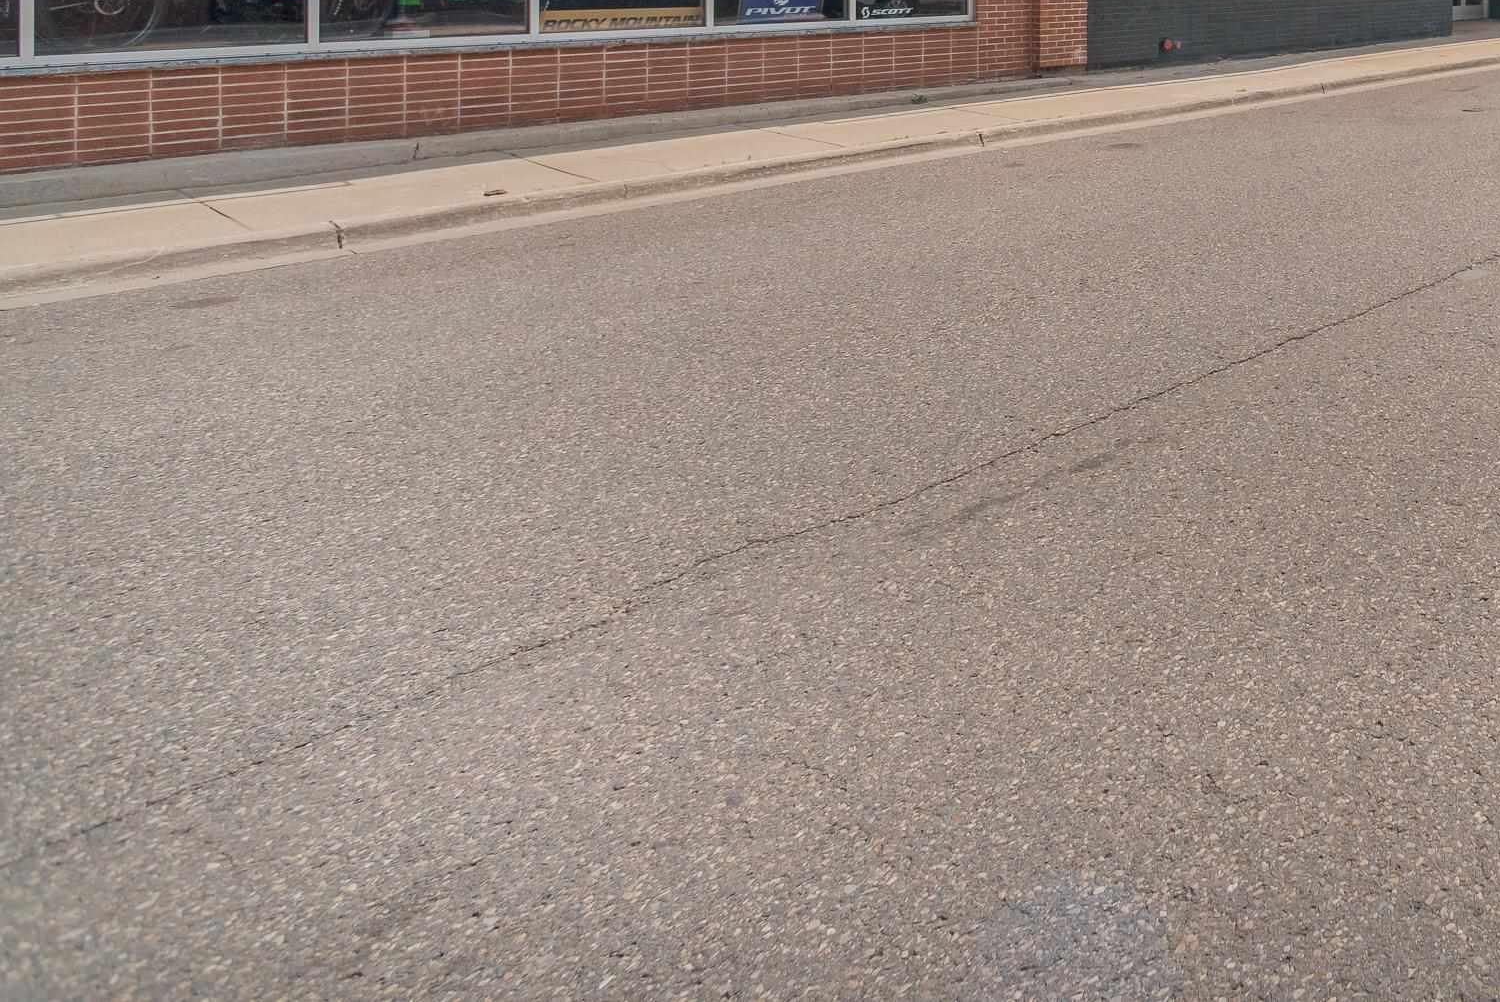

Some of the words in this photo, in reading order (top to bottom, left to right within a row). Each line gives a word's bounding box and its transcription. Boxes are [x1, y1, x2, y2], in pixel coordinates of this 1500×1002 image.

[745, 5, 817, 16] PIVOT
[870, 7, 914, 16] SCOTT
[543, 17, 608, 32] ROCKY
